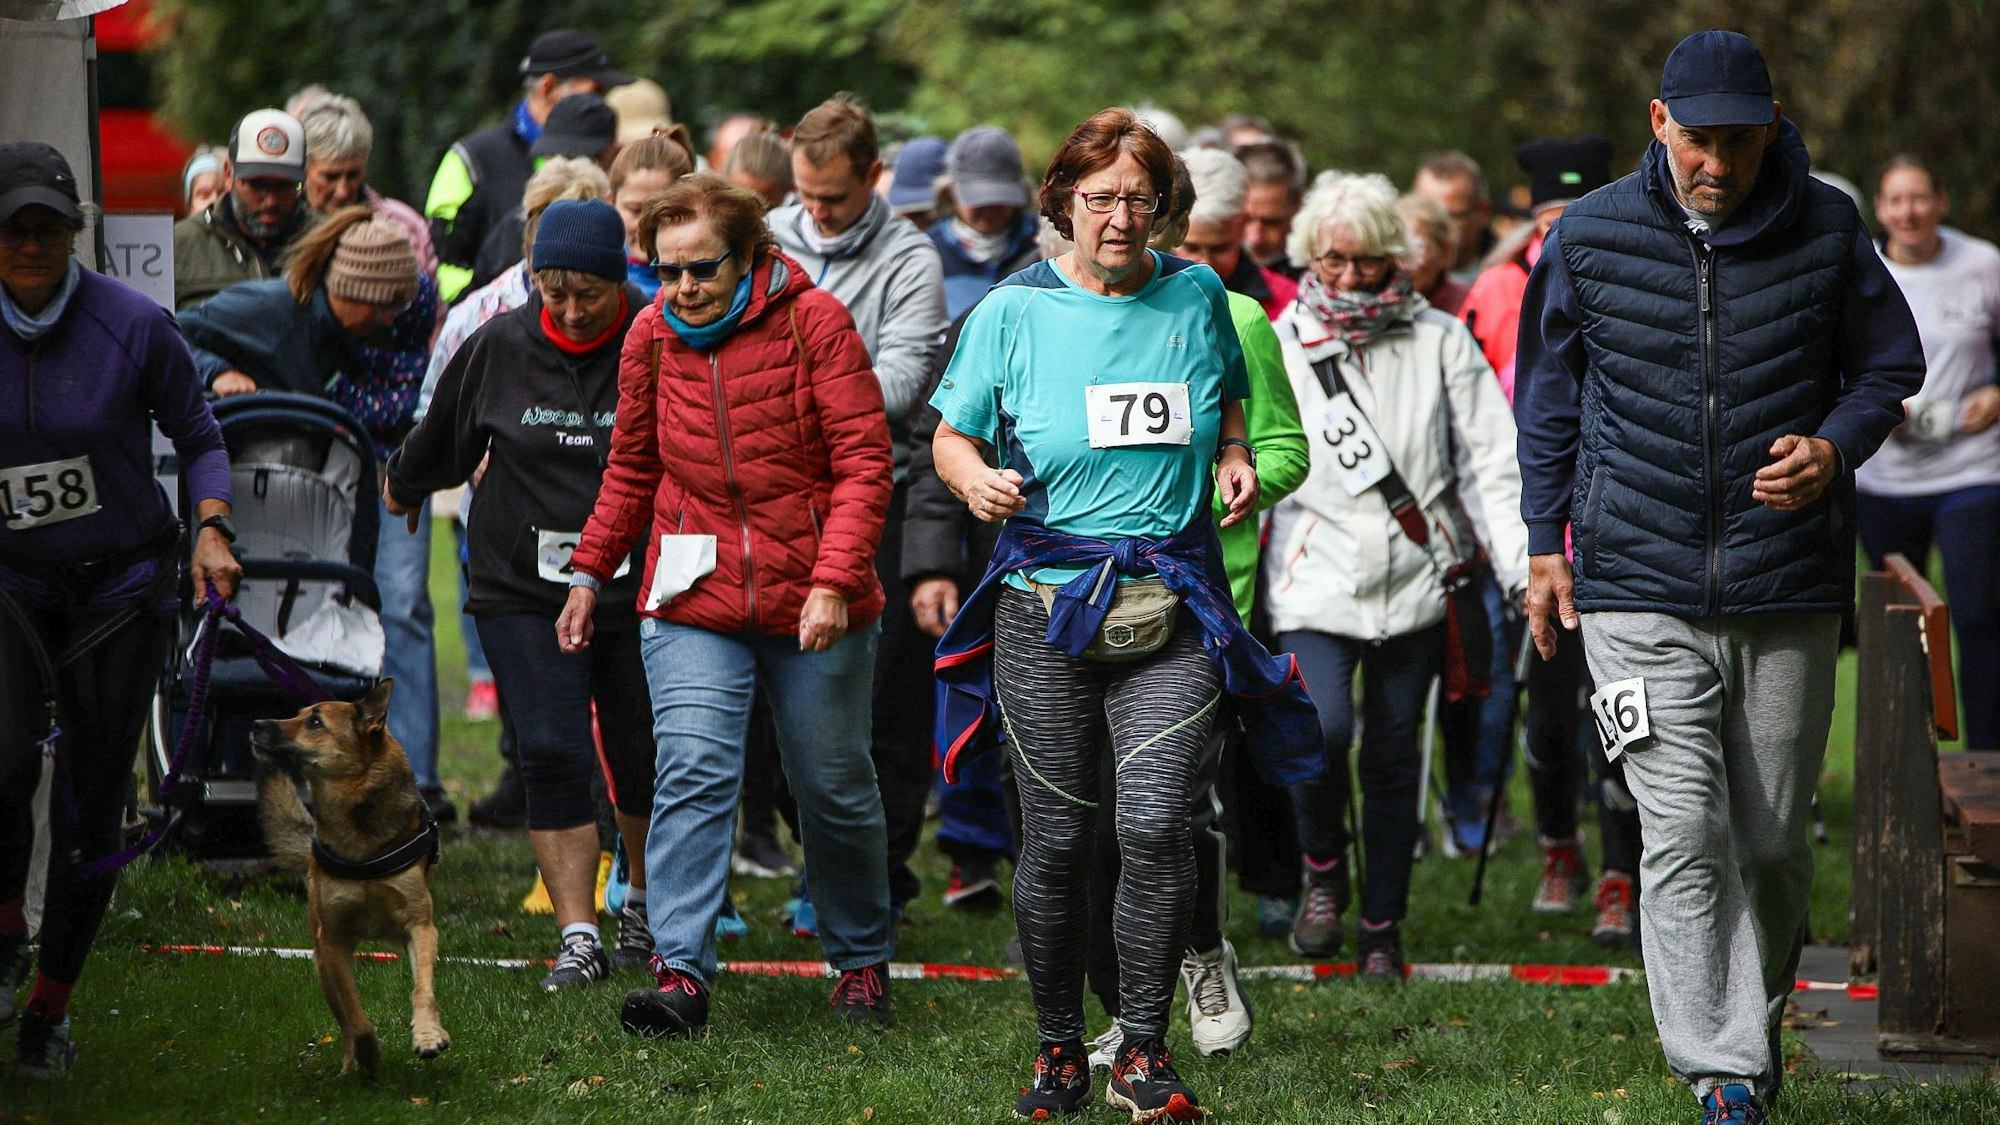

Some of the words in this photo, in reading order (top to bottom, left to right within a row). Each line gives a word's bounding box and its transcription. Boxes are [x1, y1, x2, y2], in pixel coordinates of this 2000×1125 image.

[1109, 392, 1170, 436] 79
[556, 431, 594, 446] Team
[1323, 416, 1371, 470] 33
[0, 468, 89, 521] 158
[558, 541, 577, 574] 2
[1593, 689, 1640, 752] 156
